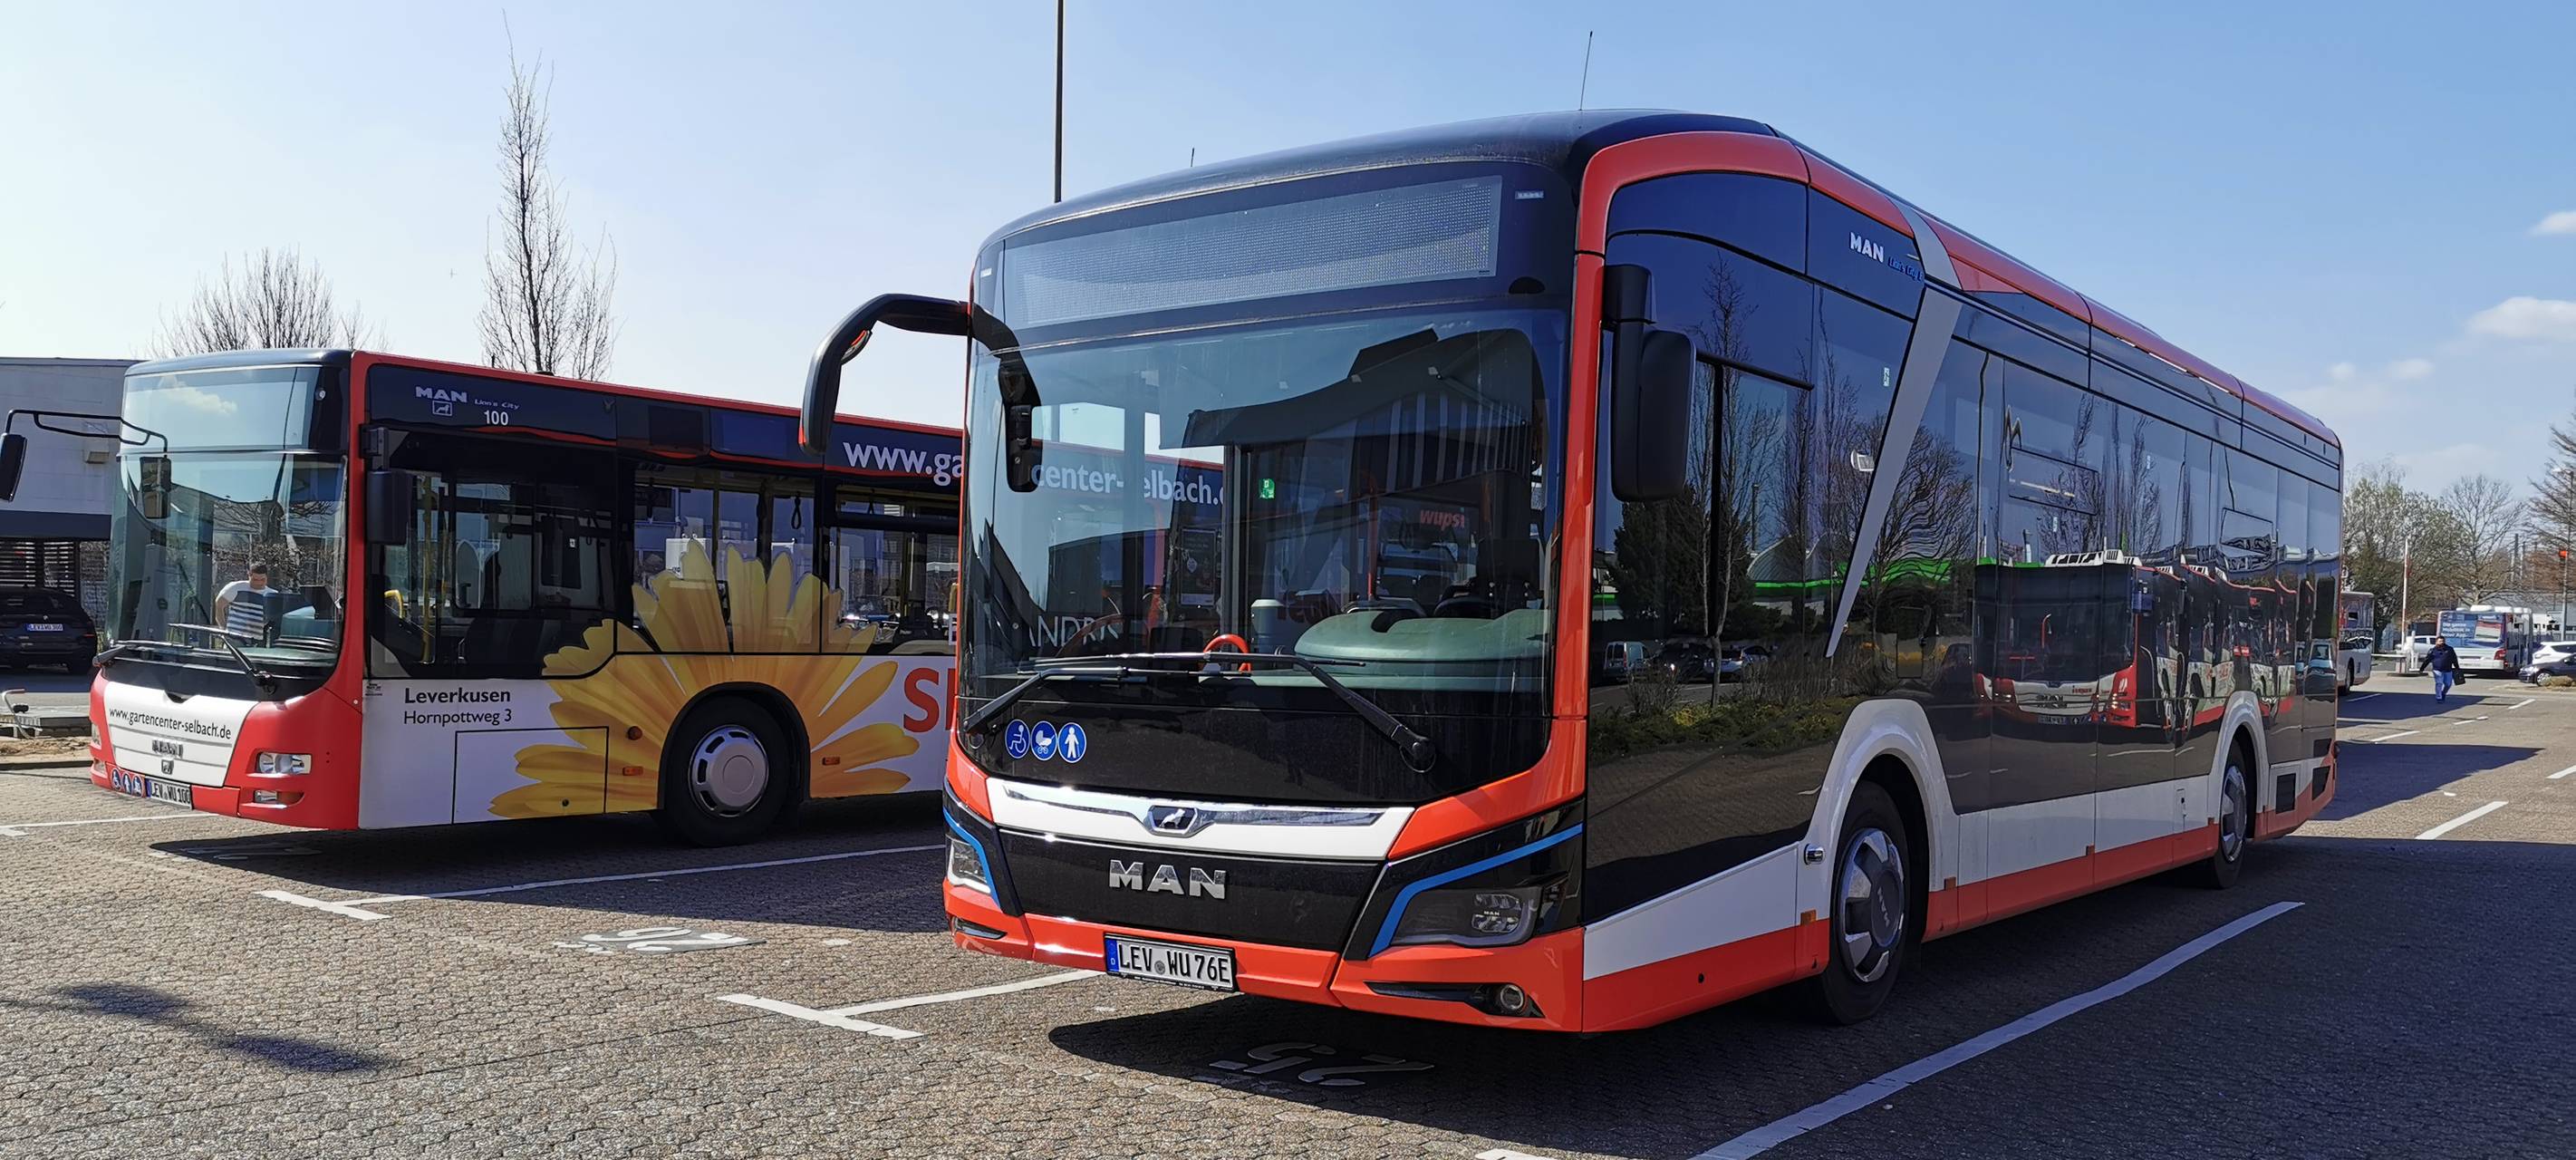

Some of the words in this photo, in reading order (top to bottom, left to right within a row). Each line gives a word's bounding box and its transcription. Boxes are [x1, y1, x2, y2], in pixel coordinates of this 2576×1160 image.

[1849, 231, 1885, 263] MAN
[415, 386, 468, 402] MAN
[484, 410, 509, 426] 100
[404, 687, 511, 704] Leverkusen
[903, 667, 957, 732] S
[109, 707, 232, 740] www.gartencenter-selbach.de
[403, 710, 500, 727] Hornpottweg
[504, 709, 513, 722] 3
[151, 781, 163, 798] LEV
[167, 785, 178, 802] WU
[178, 787, 191, 804] 100
[1109, 859, 1226, 899] MAN
[1117, 943, 1153, 972] LEV
[1166, 950, 1192, 978] WU
[1194, 954, 1230, 983] 76E
